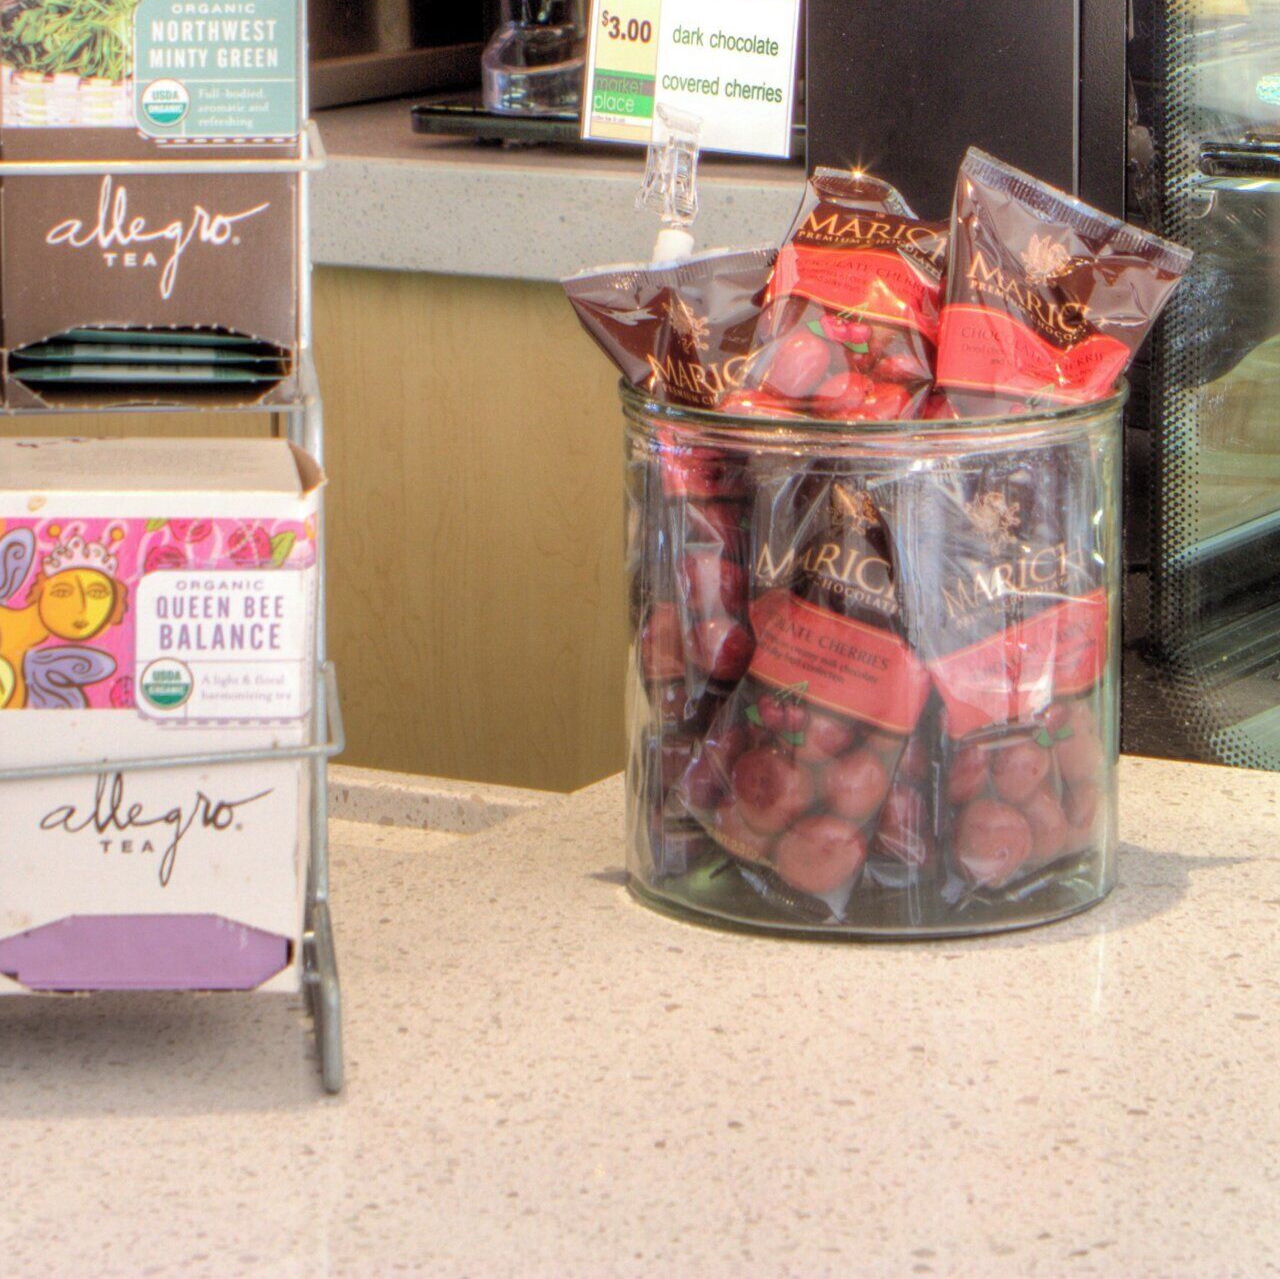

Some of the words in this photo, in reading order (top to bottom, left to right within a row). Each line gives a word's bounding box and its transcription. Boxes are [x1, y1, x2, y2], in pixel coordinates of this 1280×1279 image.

[171, 2, 257, 15] ORGANIC
[151, 19, 278, 43] NORTHWEST
[601, 8, 653, 45] $3.00
[671, 24, 705, 48] dark
[708, 28, 780, 58] chocolate
[149, 48, 209, 70] MINTY
[216, 47, 279, 69] GREEN
[593, 77, 644, 96] market
[661, 71, 720, 97] covered
[724, 78, 784, 105] cherries
[592, 92, 635, 114] place
[103, 252, 157, 267] TEA
[176, 579, 265, 592] ORGANIC
[156, 595, 231, 619] QUEEN
[243, 596, 285, 618] BEE
[159, 623, 282, 651] BALANCE
[100, 839, 156, 854] TEA
